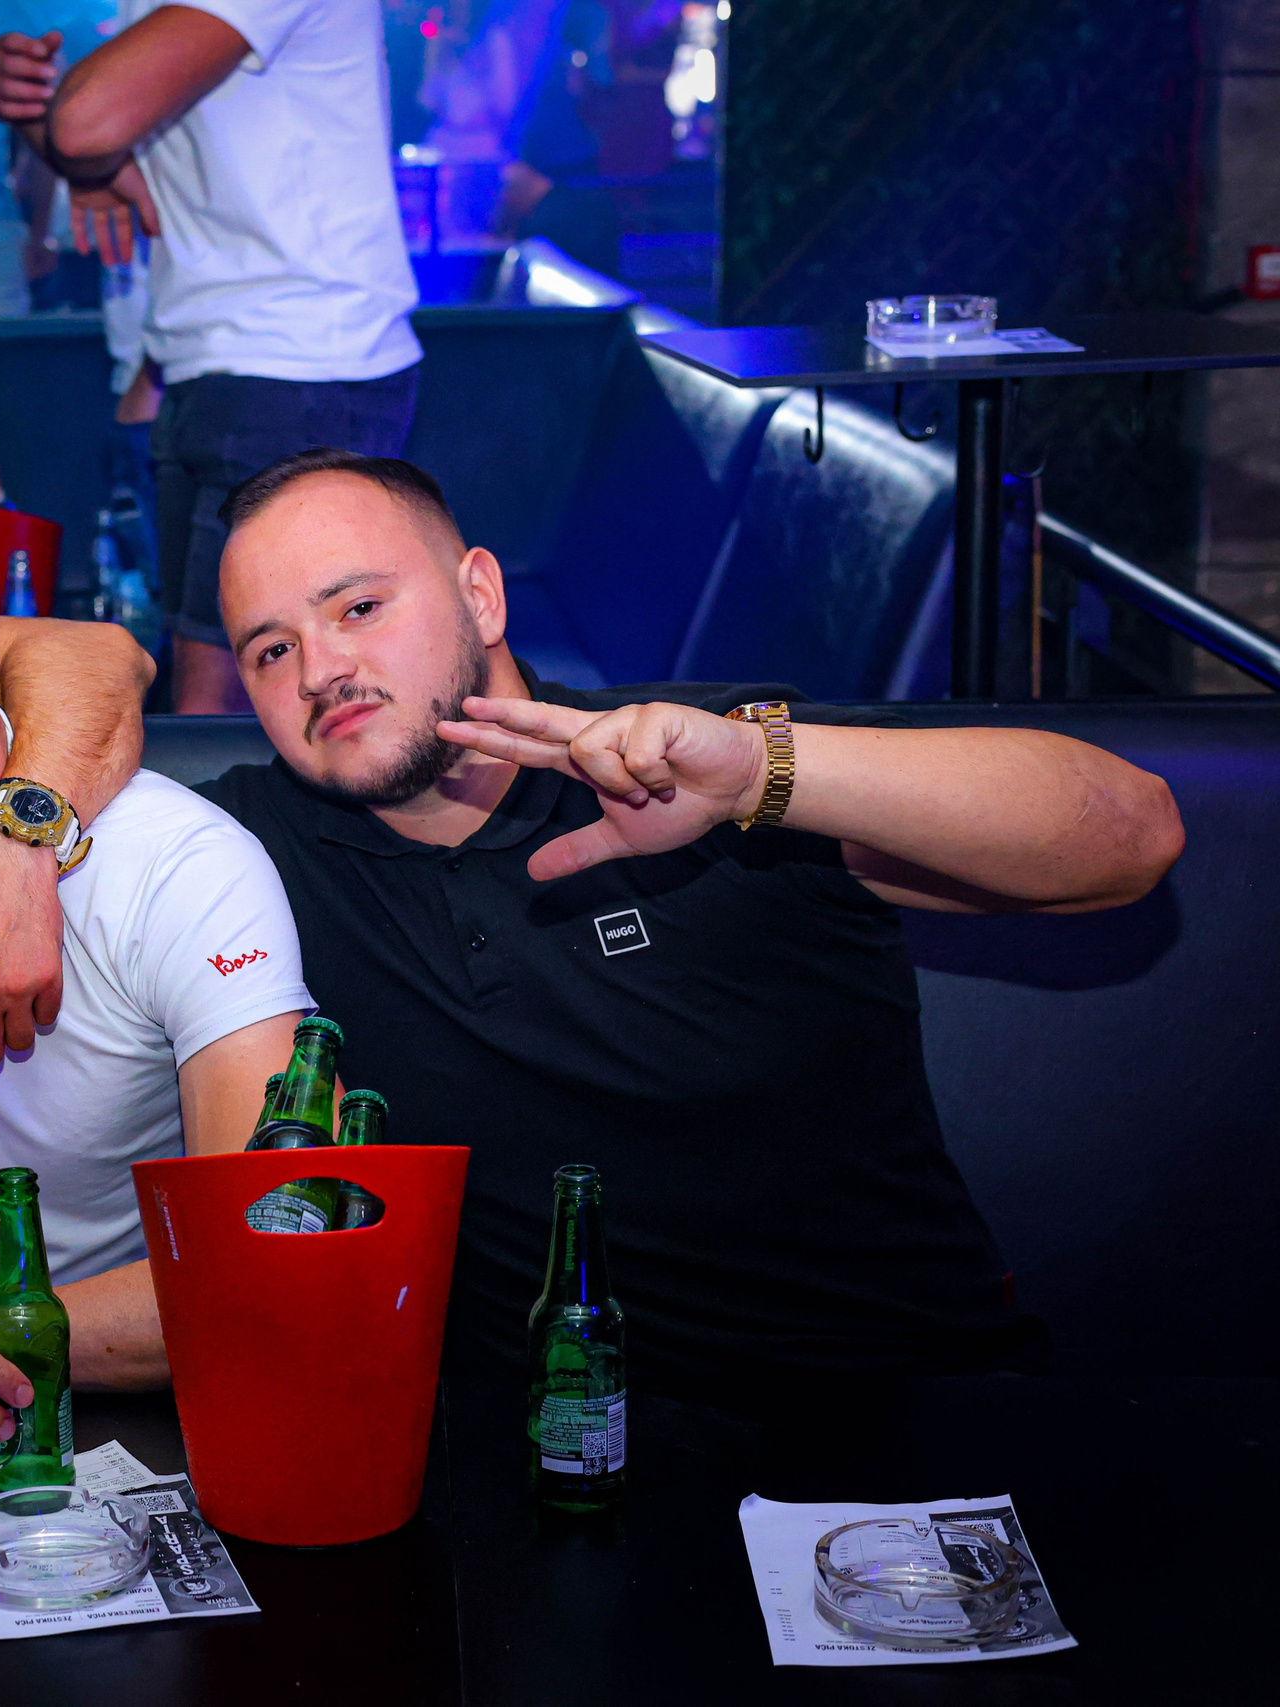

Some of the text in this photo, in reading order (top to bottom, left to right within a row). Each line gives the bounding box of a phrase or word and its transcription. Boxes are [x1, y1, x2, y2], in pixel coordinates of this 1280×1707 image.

[605, 924, 637, 941] HUGO
[207, 948, 268, 977] Boss
[162, 1205, 180, 1262] Heineken
[154, 1515, 195, 1576] SPARTA
[206, 1596, 237, 1605] SPARTA
